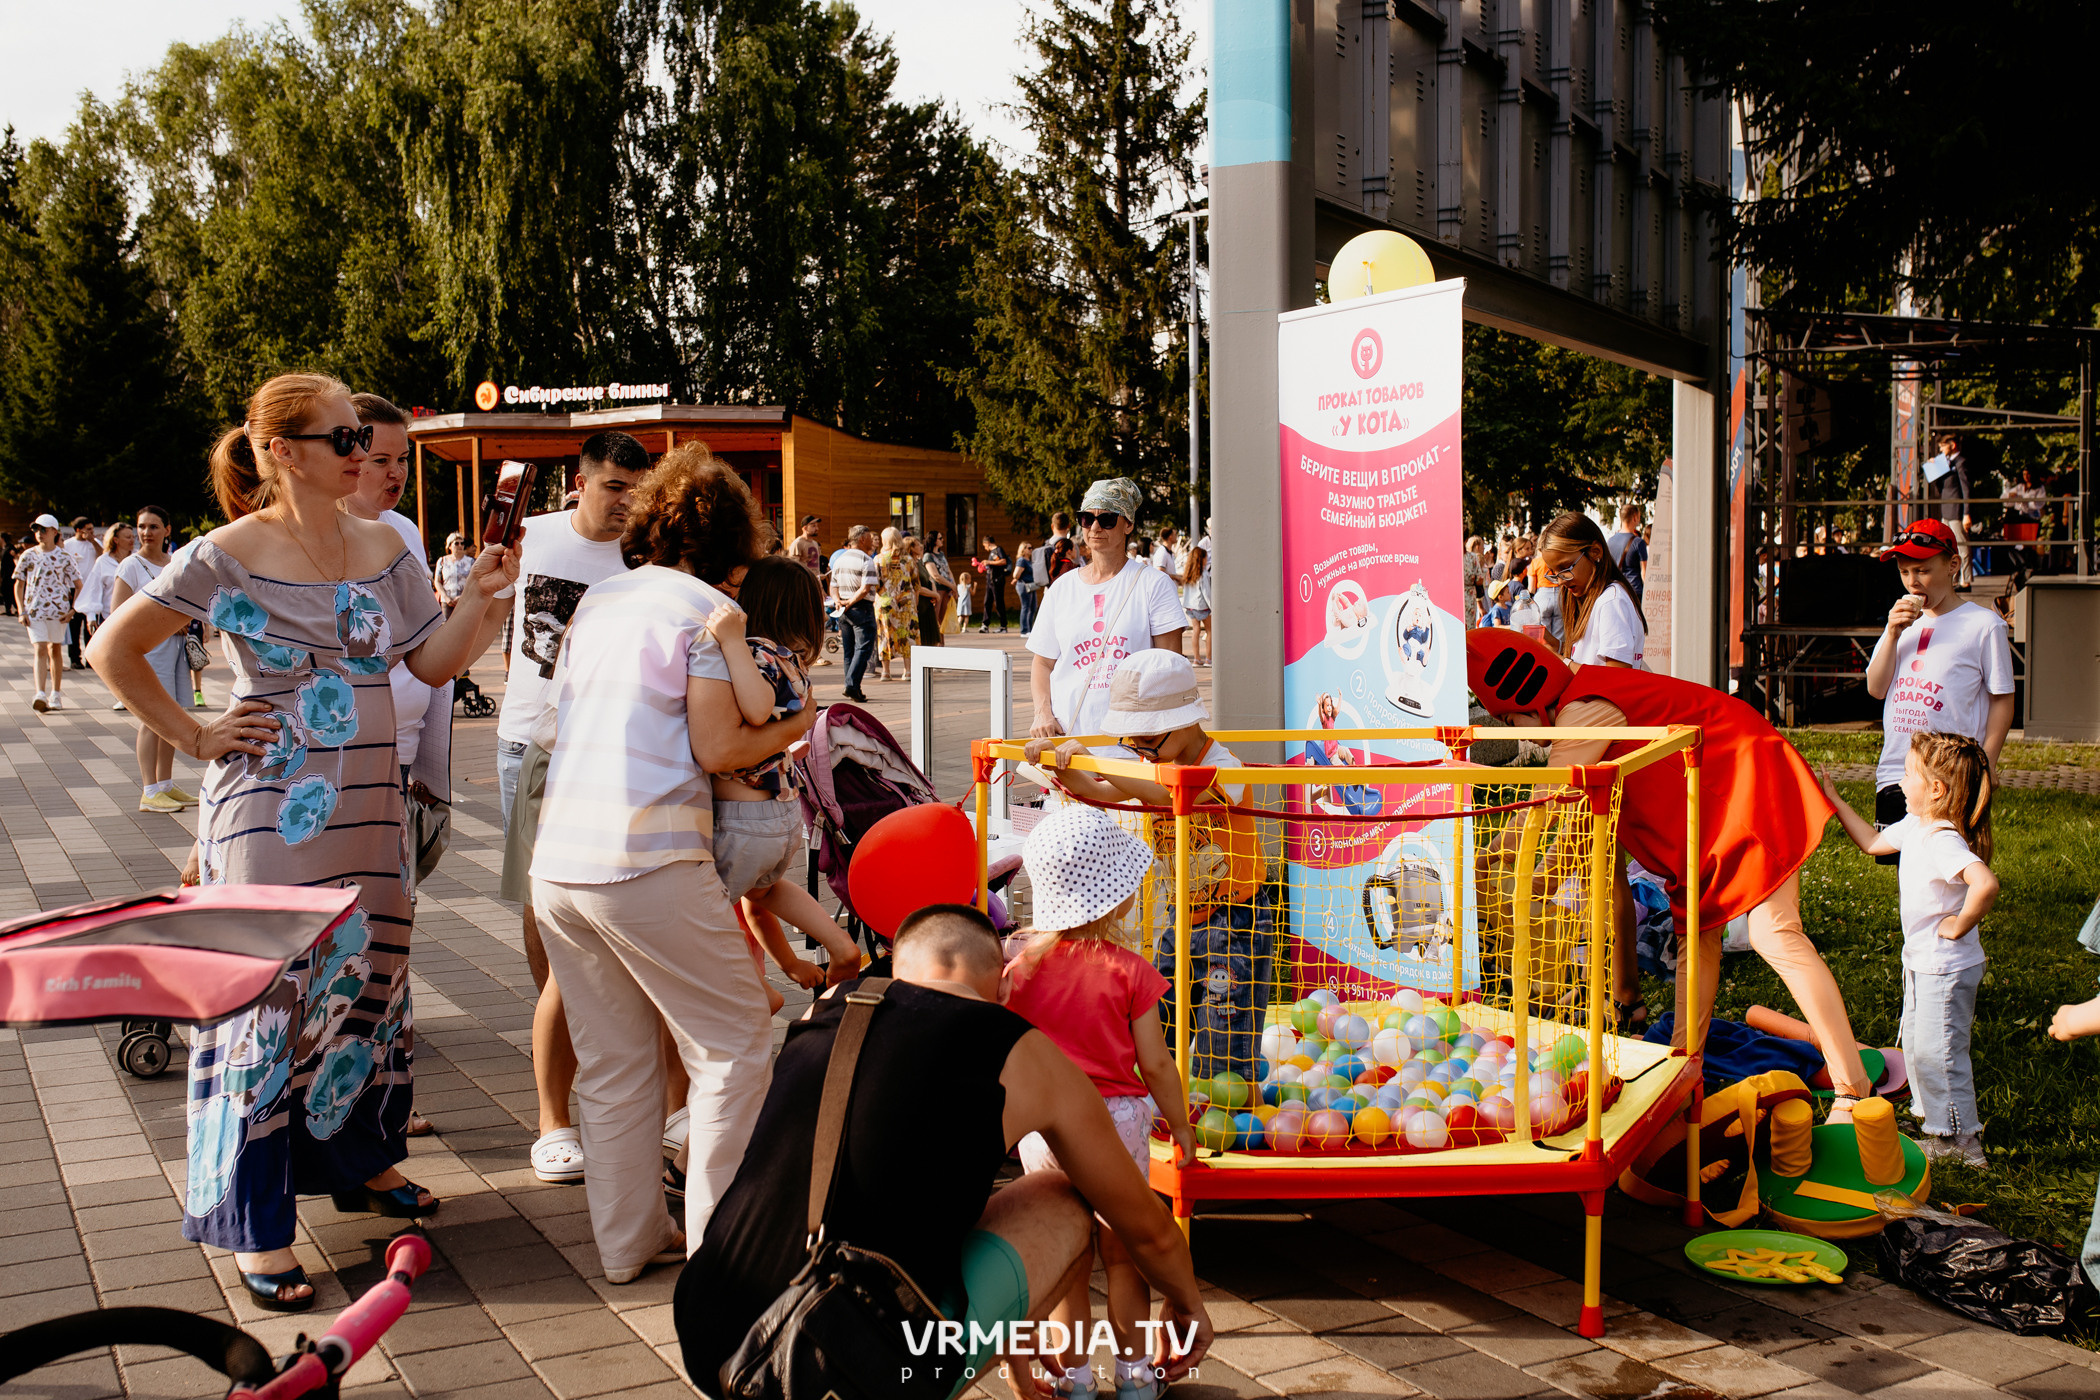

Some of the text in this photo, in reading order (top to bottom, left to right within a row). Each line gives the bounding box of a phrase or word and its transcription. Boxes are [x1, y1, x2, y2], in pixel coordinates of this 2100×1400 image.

[504, 382, 669, 405] Сибирские блины
[1318, 381, 1424, 411] ПРОКАТ ТОВАРОВ
[1332, 408, 1409, 437] «У КОТА»
[1300, 454, 1340, 485] БЕРИТЕ
[1342, 469, 1378, 490] ВЕЩИ
[1381, 469, 1389, 486] В
[1390, 445, 1440, 483] ПРОКАТ
[1328, 485, 1418, 510] РАЗУМНО ТРАТЬТЕ
[1320, 500, 1428, 529] СЕМЕЙНЫЙ БЮДЖЕТ!
[1313, 542, 1379, 575] Возьмите товары,
[1317, 553, 1420, 588] нужные на короткое время
[1893, 691, 1944, 712] ОВАРОВ
[1425, 788, 1431, 797] в
[82, 972, 142, 991] Family
[1389, 962, 1424, 979] порядок
[1426, 971, 1431, 979] в
